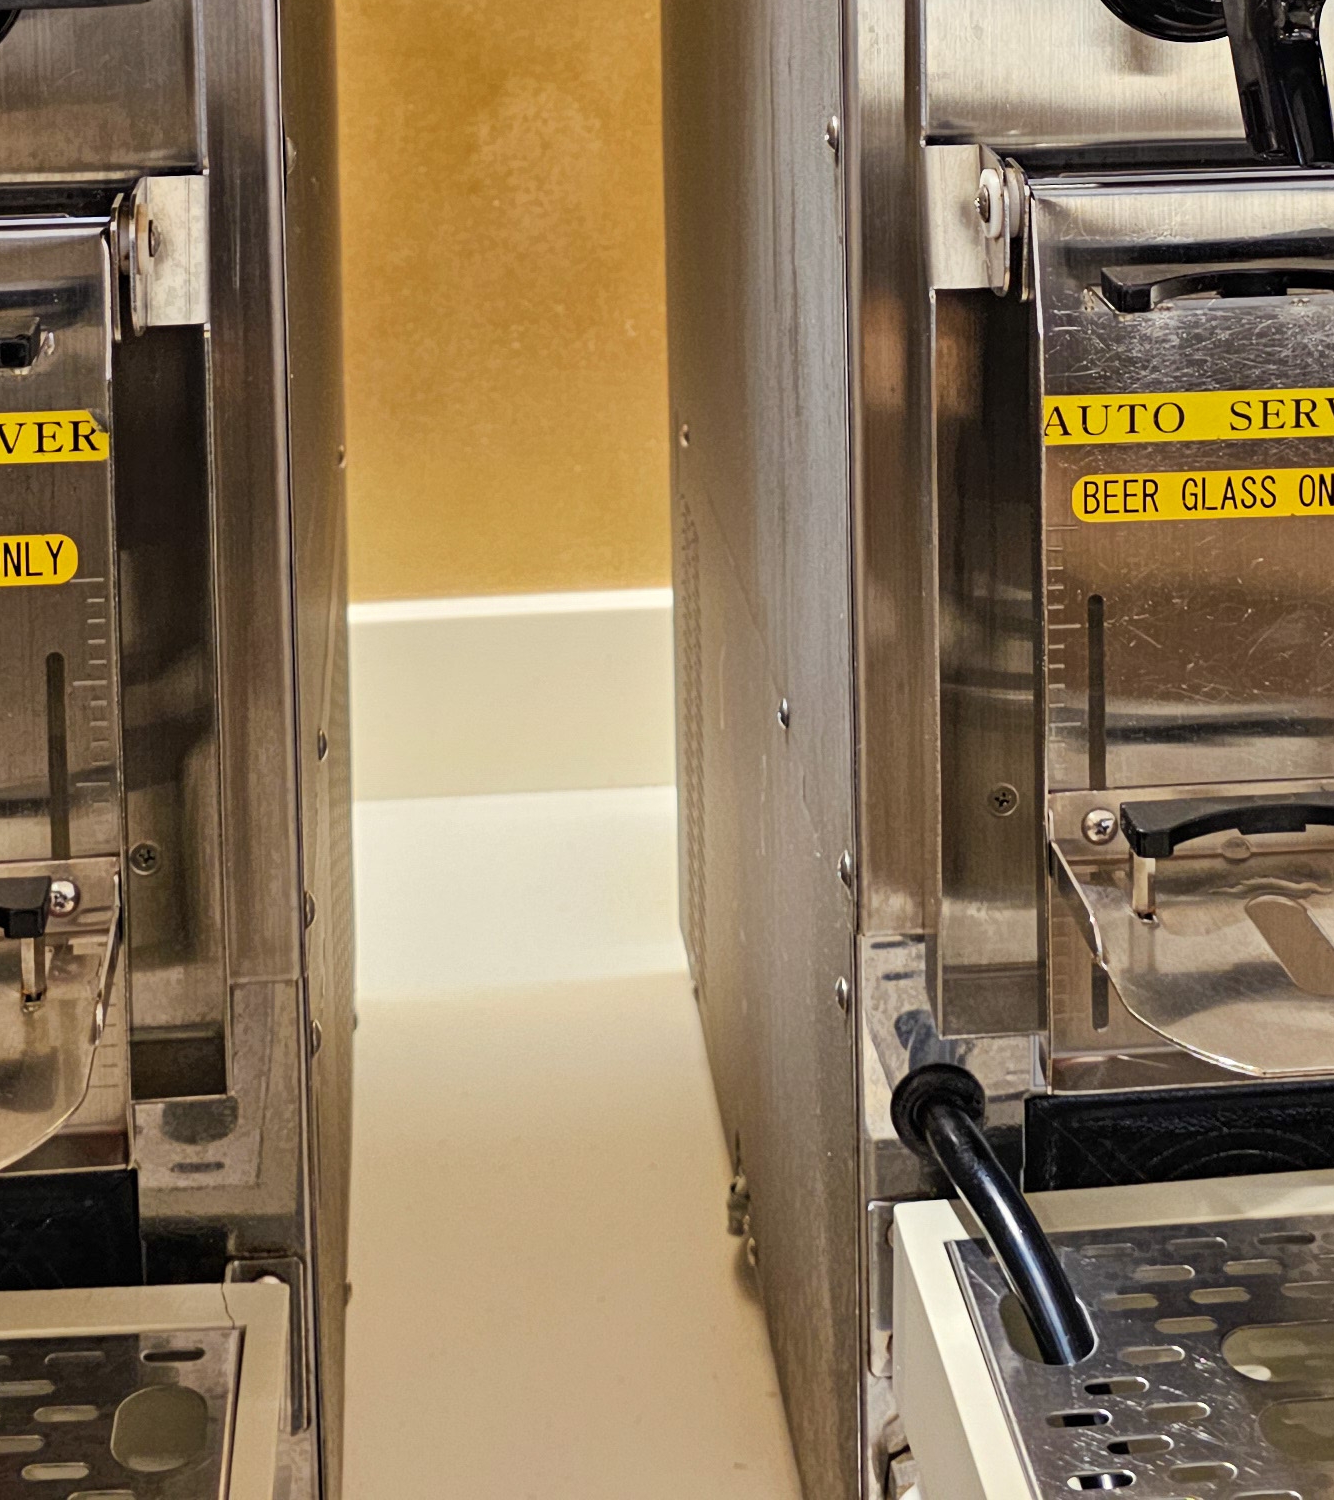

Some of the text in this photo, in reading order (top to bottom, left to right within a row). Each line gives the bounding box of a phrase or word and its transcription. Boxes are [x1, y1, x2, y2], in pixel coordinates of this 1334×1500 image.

[1044, 402, 1185, 437] AUTO
[1084, 479, 1159, 515] BEER
[1182, 475, 1276, 511] GLASS
